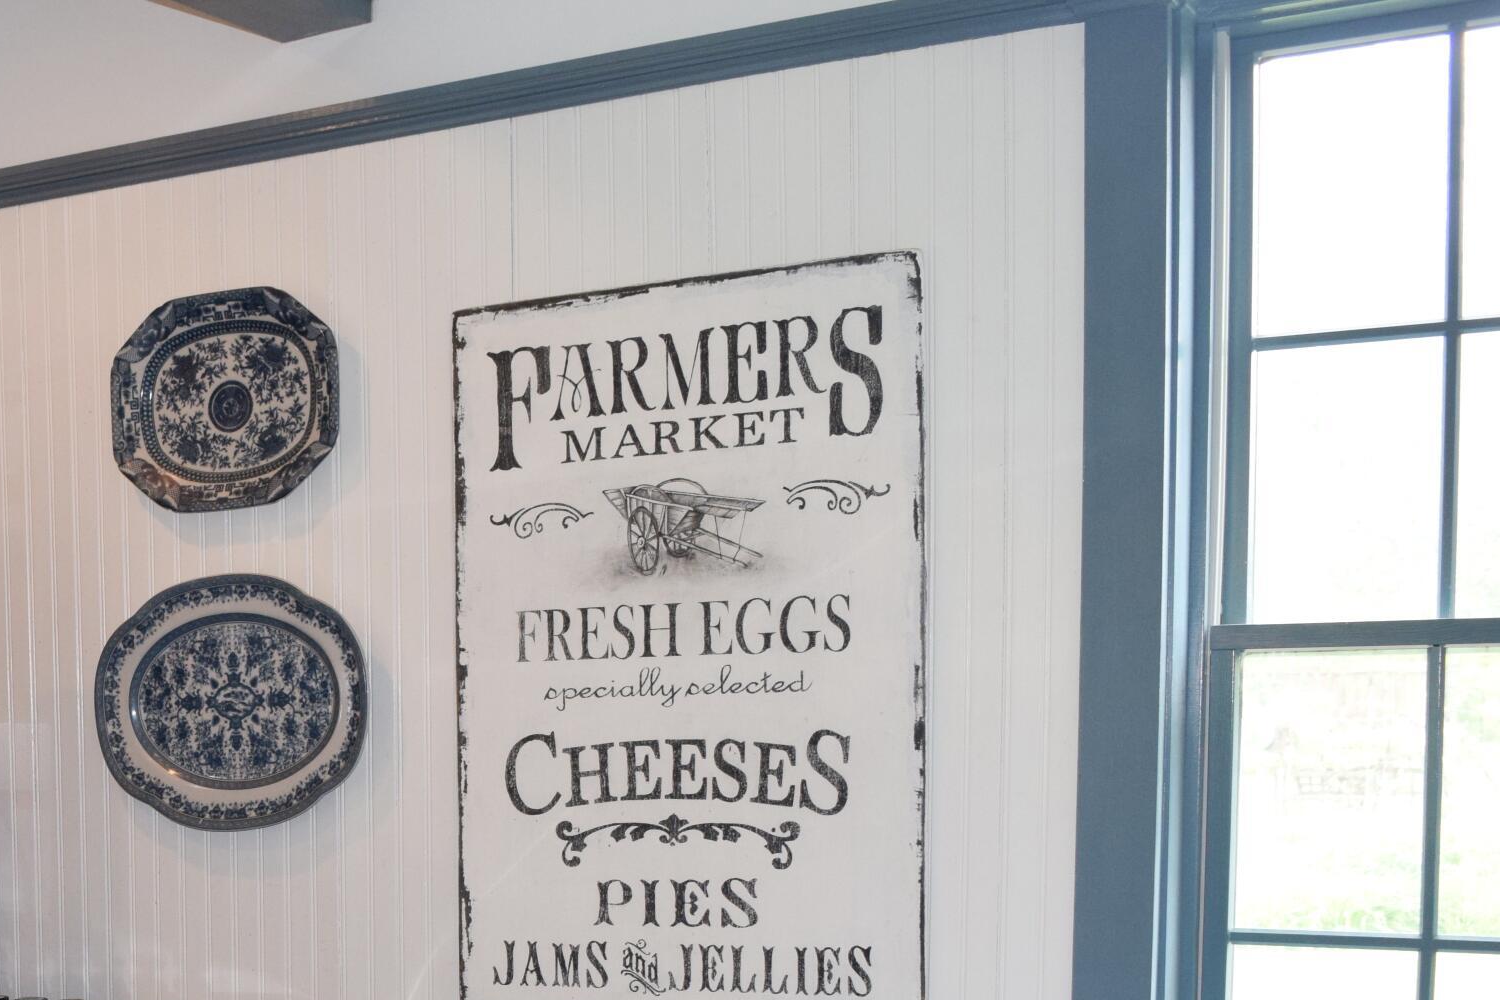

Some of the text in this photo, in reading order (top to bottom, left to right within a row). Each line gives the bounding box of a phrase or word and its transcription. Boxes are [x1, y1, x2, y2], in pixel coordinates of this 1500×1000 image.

[487, 305, 884, 472] FARMERS
[560, 407, 805, 464] MARKET
[516, 594, 852, 663] FRESH EGGS
[543, 664, 813, 711] specially selected
[504, 729, 852, 816] CHEESES
[594, 877, 759, 929] PIES
[492, 940, 873, 997] JAMS and JELLIES
